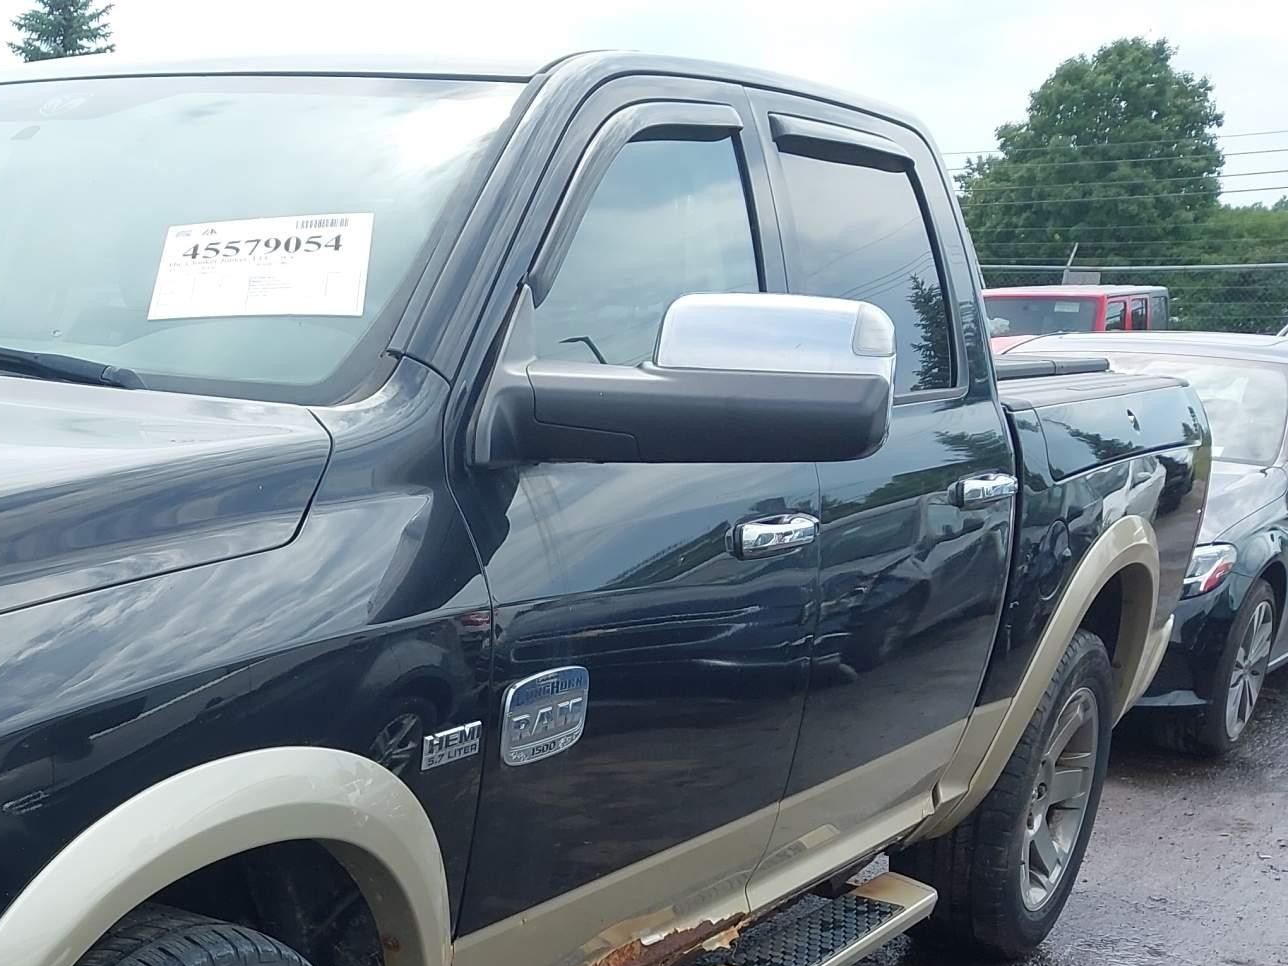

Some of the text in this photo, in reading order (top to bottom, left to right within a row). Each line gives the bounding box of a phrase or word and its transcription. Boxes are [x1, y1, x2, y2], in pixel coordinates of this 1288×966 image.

[182, 233, 343, 260] 45579054
[512, 697, 583, 741] RAM
[423, 720, 482, 754] HEMI
[531, 741, 557, 756] 1500
[427, 743, 478, 767] 5.7 LITER
